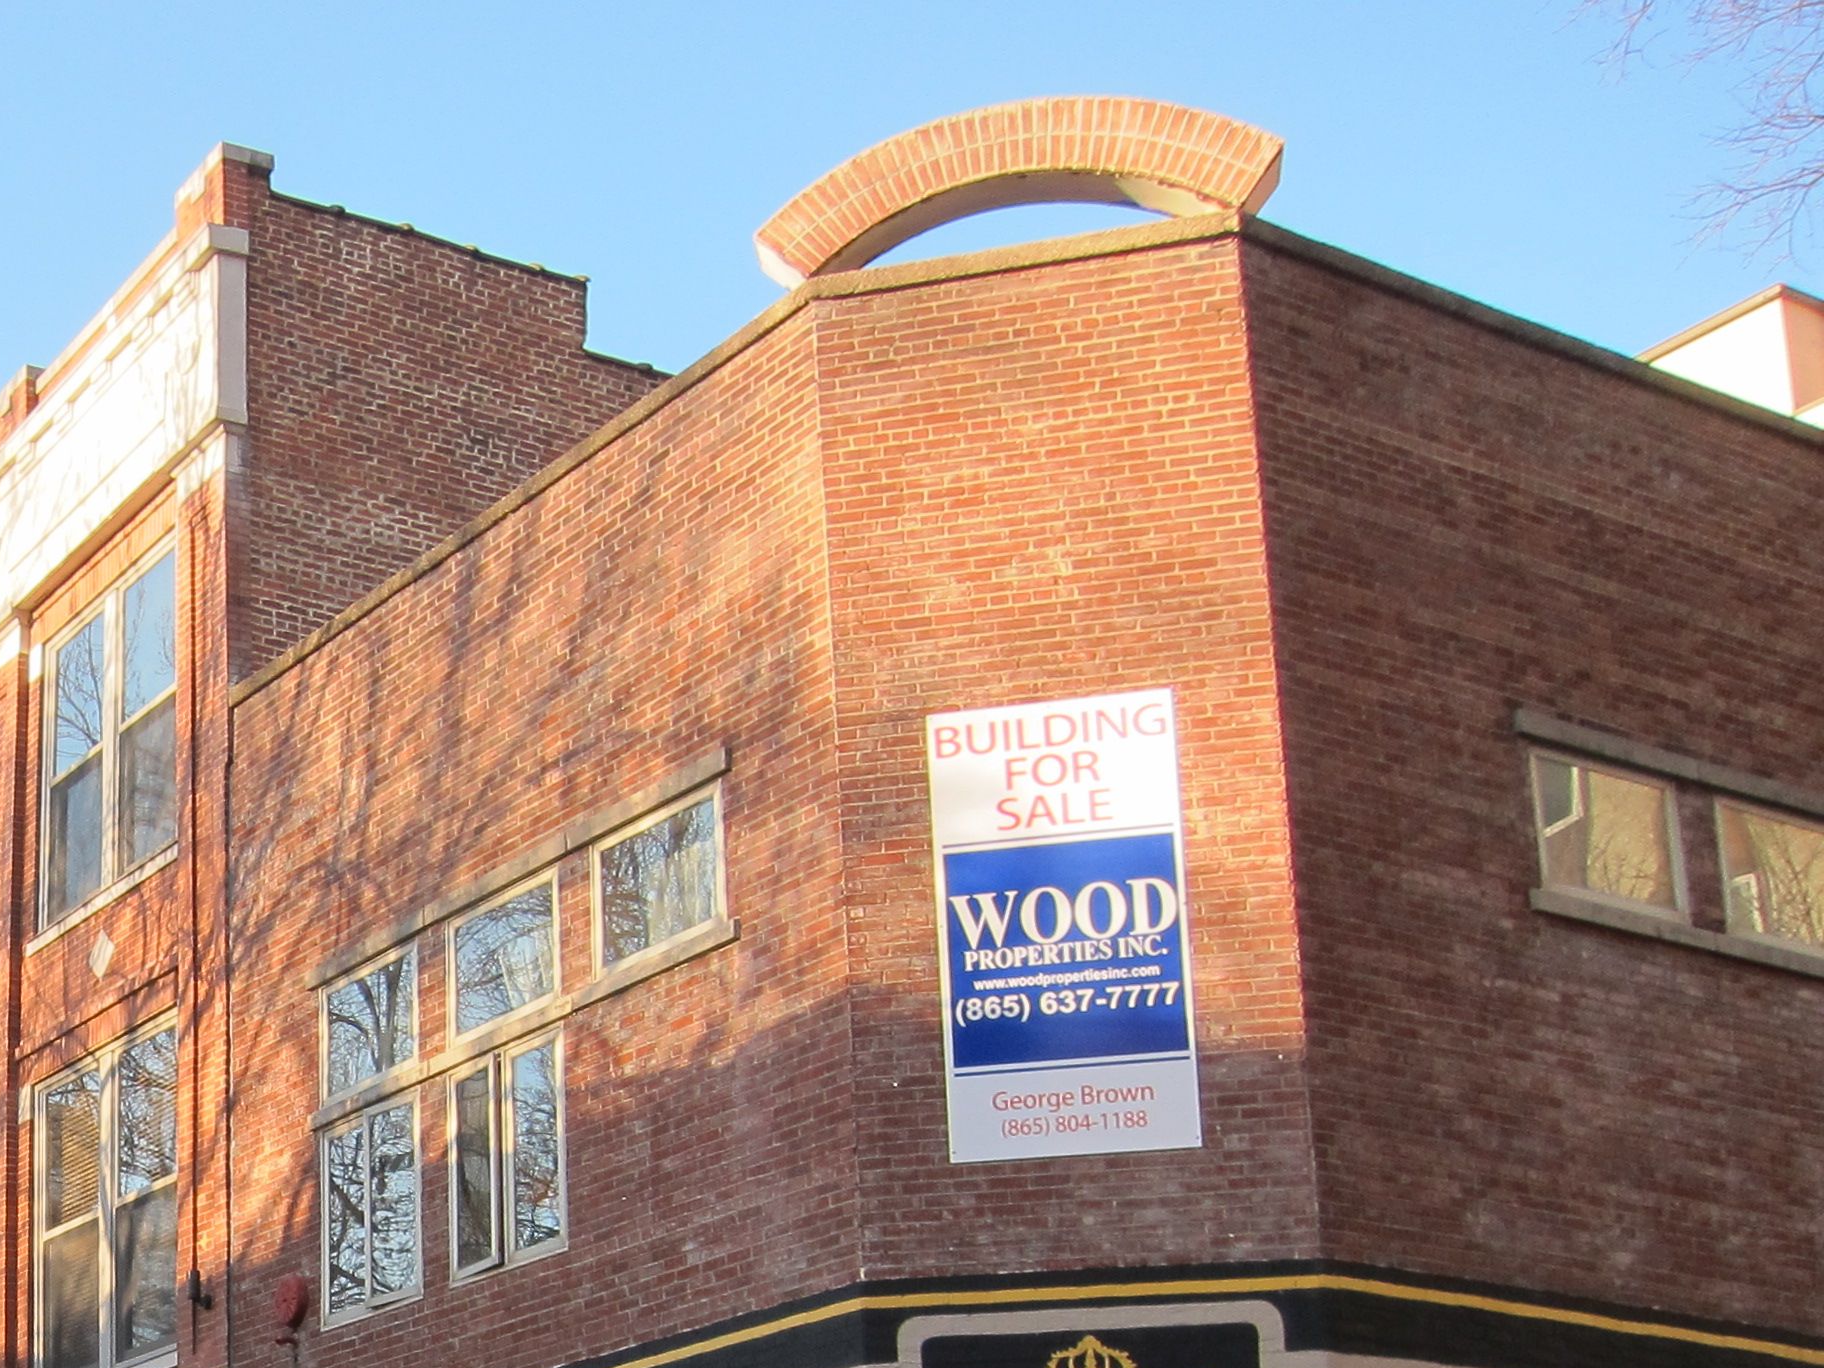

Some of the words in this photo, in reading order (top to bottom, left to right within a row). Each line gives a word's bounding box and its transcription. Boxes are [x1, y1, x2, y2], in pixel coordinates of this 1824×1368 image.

[933, 703, 1168, 759] BUILDING
[1005, 751, 1100, 791] FOR
[996, 788, 1113, 831] SALE
[949, 877, 1177, 950] WOOD
[963, 939, 1113, 972] PROPERTIES
[1118, 935, 1169, 958] INC.
[973, 964, 1161, 990] www.woodpropertiesinc.com
[955, 993, 1031, 1027] (865)
[1039, 981, 1180, 1015] 637-7777
[991, 1090, 1075, 1113] George
[1080, 1084, 1155, 1106] Brown
[1001, 1115, 1050, 1138] (865)
[1055, 1110, 1149, 1134] 804-1188
